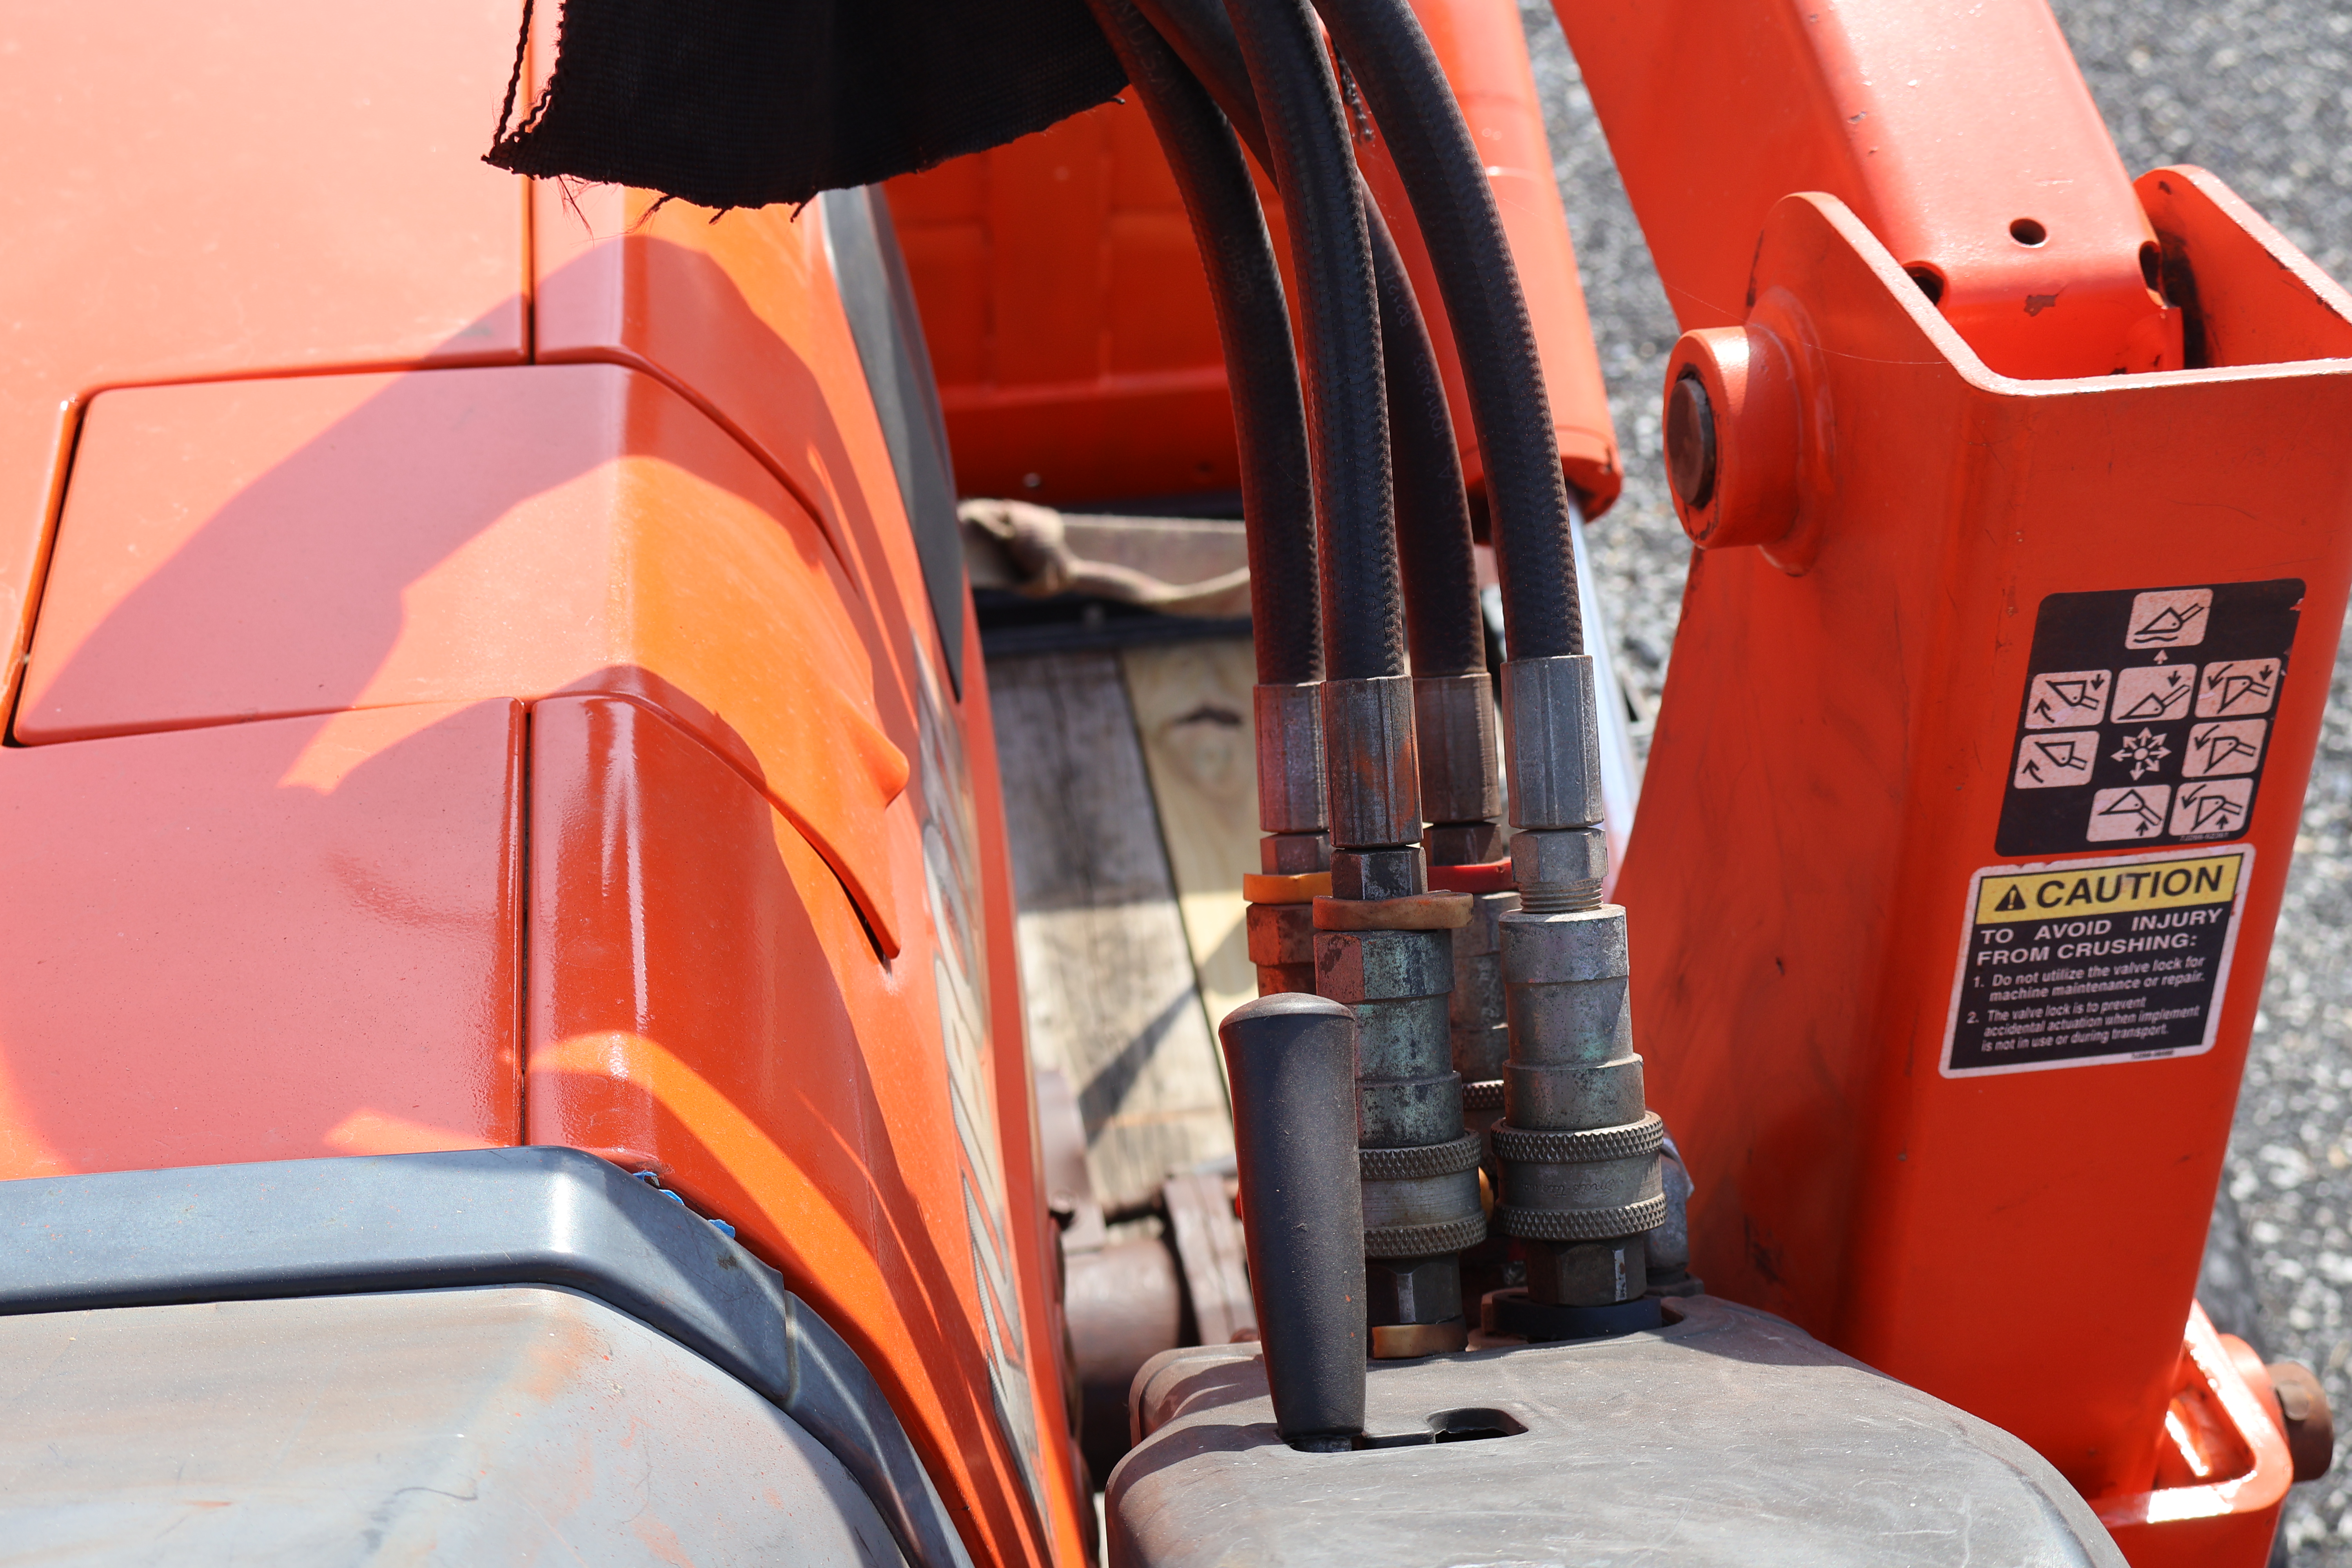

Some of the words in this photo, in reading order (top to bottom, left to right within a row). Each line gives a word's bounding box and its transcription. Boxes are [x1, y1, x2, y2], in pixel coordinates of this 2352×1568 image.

[1381, 263, 1414, 327] B21271
[1413, 352, 1445, 438] 10012403
[2036, 865, 2223, 909] CAUTION
[1980, 927, 2014, 944] TO
[2033, 919, 2112, 941] AVOID
[2131, 907, 2223, 931] INJURY
[1976, 946, 2051, 966] FROM
[2057, 932, 2198, 959] CRUSHING:
[1973, 975, 1985, 988] 1.
[1992, 974, 2013, 987] Do
[2015, 972, 2039, 985] not
[2042, 967, 2085, 982] utilize
[2087, 965, 2111, 978] the
[2113, 961, 2151, 975] valve
[2152, 956, 2183, 971] lock
[2185, 955, 2207, 968] for
[1989, 986, 2049, 1002] machine
[2051, 978, 2141, 996] maintenance
[2143, 976, 2160, 987] or
[2161, 969, 2205, 987] repair.
[1967, 1011, 1979, 1024] 2.
[1987, 1009, 2010, 1022] The
[2012, 1006, 2044, 1020] valve
[2045, 1002, 2071, 1017] lock
[2073, 1002, 2085, 1014] is
[2086, 1001, 2100, 1013] to
[2100, 996, 2147, 1014] prevent
[1984, 1020, 2046, 1037] accidental
[2047, 1016, 2103, 1031] actuation
[2105, 1012, 2137, 1025] when
[2138, 1004, 2200, 1024] implement
[1981, 1039, 1993, 1052] is
[1994, 1038, 2016, 1051] not
[2017, 1036, 2030, 1049] in
[2031, 1036, 2054, 1047] use
[2055, 1034, 2070, 1045] or
[2070, 1029, 2110, 1044] during
[2111, 1023, 2169, 1040] transport.
